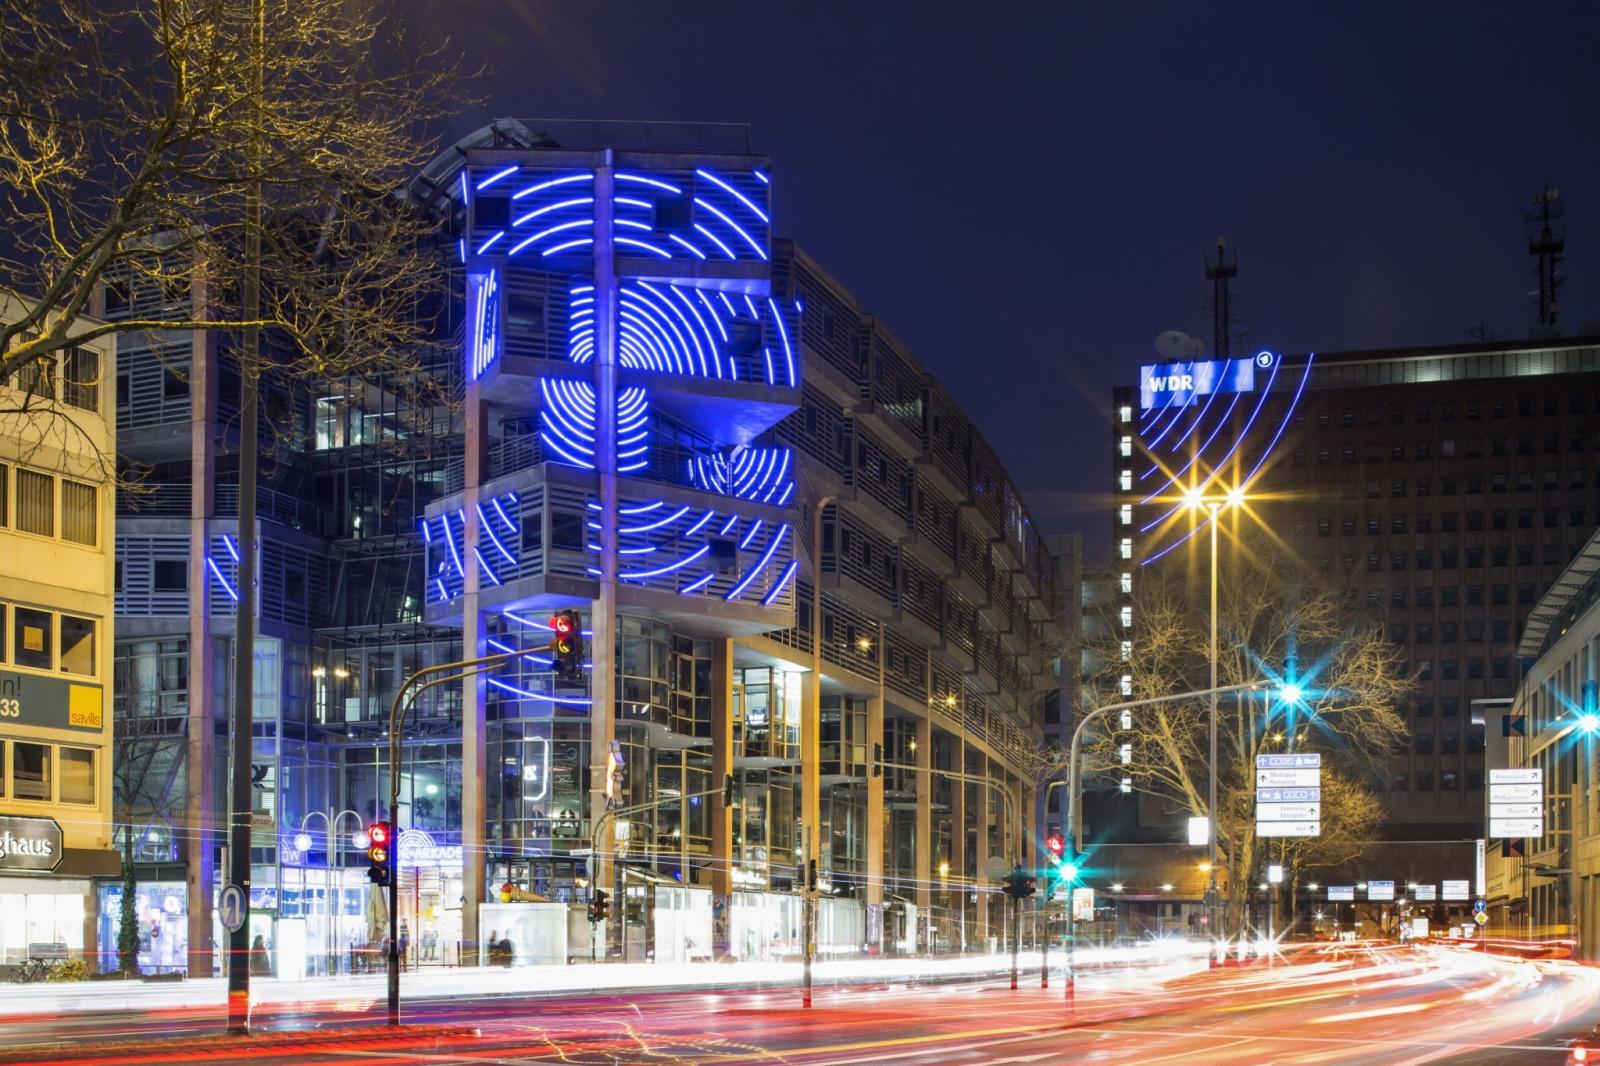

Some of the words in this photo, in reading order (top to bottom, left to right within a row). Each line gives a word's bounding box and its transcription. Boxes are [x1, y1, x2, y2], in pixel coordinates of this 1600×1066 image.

[1149, 375, 1193, 392] WDR
[0, 673, 20, 697] n!
[71, 711, 101, 727] savills
